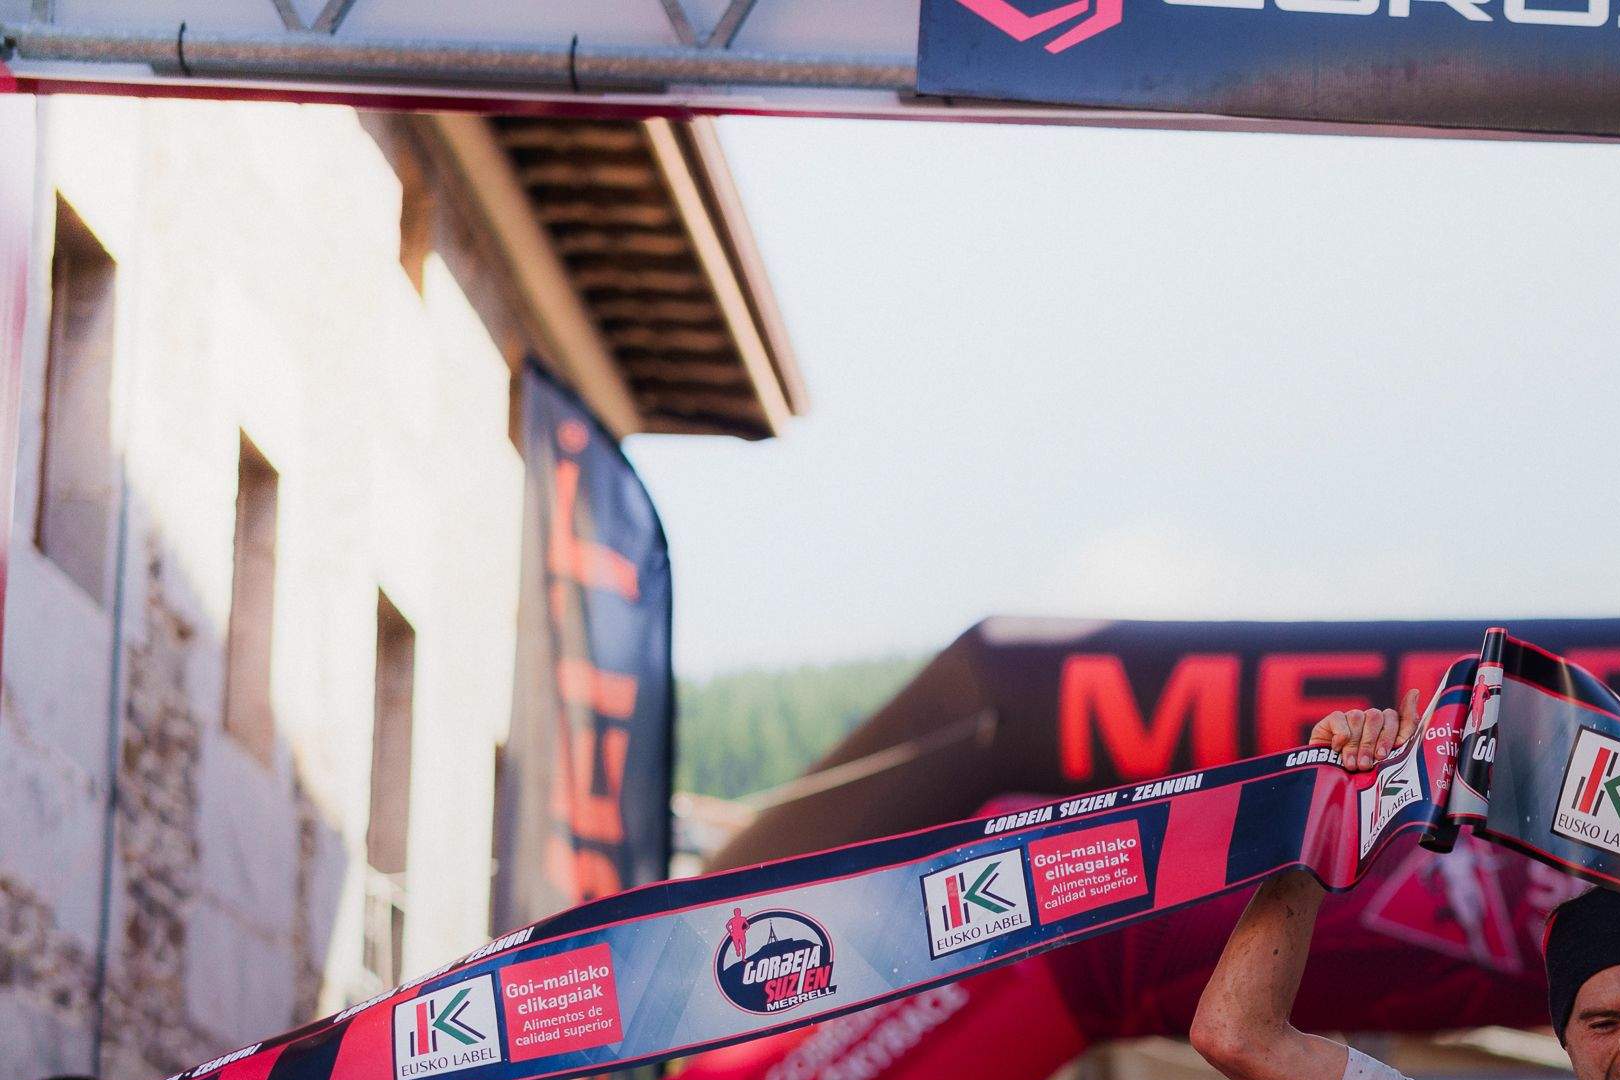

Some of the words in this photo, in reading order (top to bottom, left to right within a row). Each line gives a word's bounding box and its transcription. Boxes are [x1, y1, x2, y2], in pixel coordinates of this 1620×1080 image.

[1286, 748, 1345, 768] GORBE
[984, 805, 1052, 835] GORBEIA
[1059, 792, 1117, 818] SUZIEN
[1132, 773, 1204, 802] ZEANURI
[1558, 813, 1601, 839] EUSKO
[1034, 838, 1137, 868] Goi-mailako
[1045, 852, 1130, 882] elikagaiak
[1044, 890, 1087, 910] calidad
[1090, 874, 1139, 898] superior
[1050, 872, 1111, 896] Alimentos
[1114, 866, 1129, 878] de
[937, 926, 981, 951] EUSKO
[986, 913, 1027, 936] LABEL
[742, 945, 820, 985] GORBEIA
[506, 964, 610, 999] Goi-mailako
[764, 965, 831, 1002] SUZIEN
[518, 985, 604, 1015] elikagaiak
[767, 985, 835, 1011] MERRELL
[515, 1029, 560, 1047] calidad
[563, 1017, 613, 1041] superior
[523, 1012, 584, 1032] Alimentos
[588, 1006, 603, 1018] de
[402, 1056, 449, 1077] EUSKO
[454, 1048, 497, 1066] LABEL
